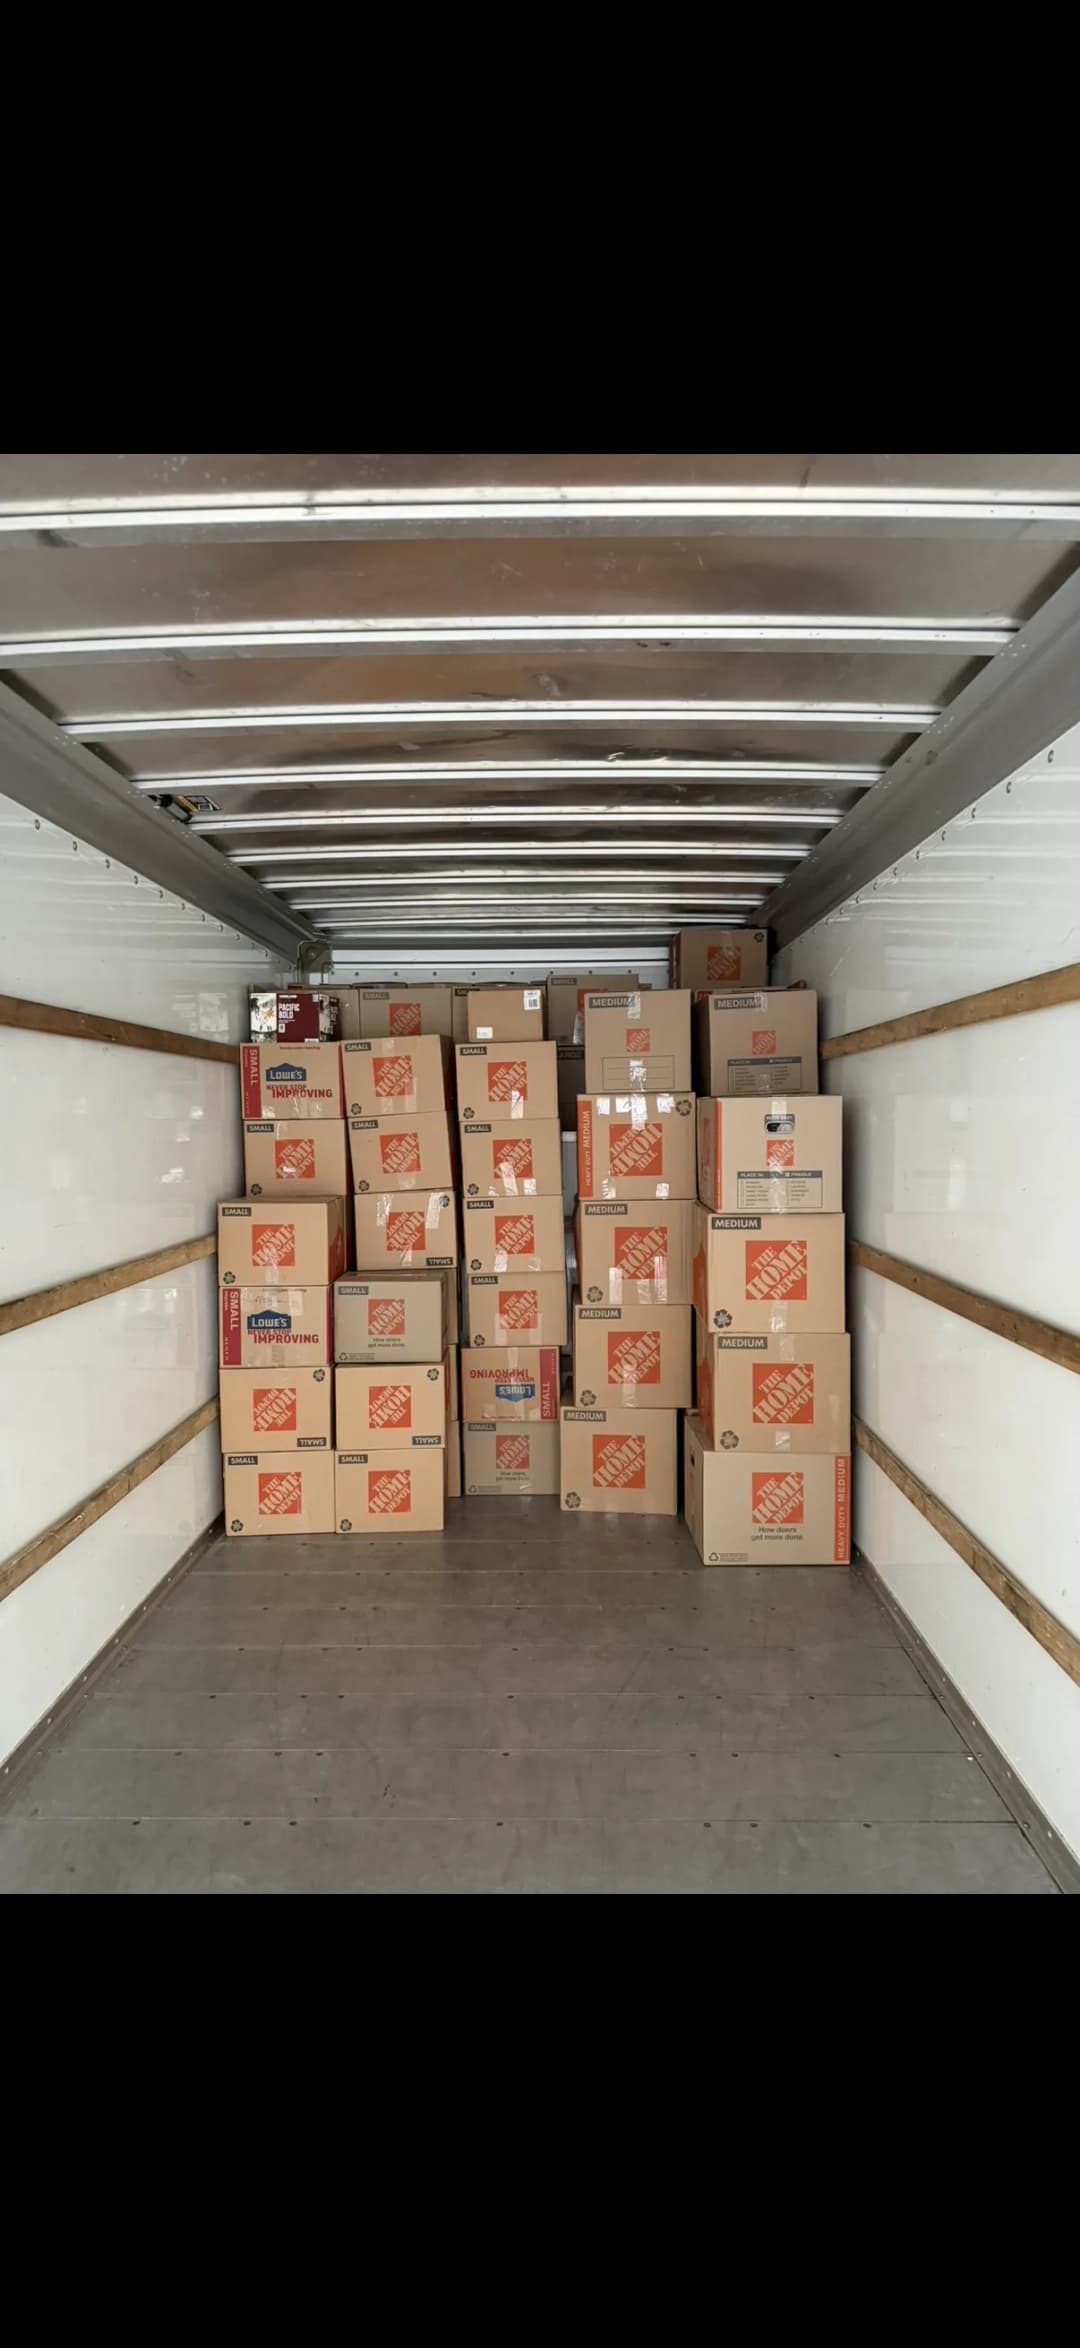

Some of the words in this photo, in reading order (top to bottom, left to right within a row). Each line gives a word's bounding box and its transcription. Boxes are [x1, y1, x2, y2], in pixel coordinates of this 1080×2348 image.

[278, 1003, 300, 1012] PACIFIC
[278, 1011, 294, 1019] BOLD
[592, 998, 632, 1007] MEDIUM
[717, 999, 759, 1008] MEDIUM
[249, 1048, 259, 1086] SMALL
[269, 1069, 303, 1080] LOWE'S
[375, 1056, 412, 1096] HOME
[489, 1061, 526, 1101] HOME
[271, 1088, 333, 1099] IMPROVING
[583, 1110, 592, 1148] MEDIUM
[276, 1139, 313, 1179] HOME
[383, 1132, 417, 1172] HOME
[610, 1124, 662, 1175] HOME
[587, 1205, 625, 1213] MEDIUM
[714, 1219, 758, 1228] MEDIUM
[252, 1224, 294, 1266] HOME
[387, 1212, 424, 1251] HOME
[496, 1215, 533, 1252] HOME
[619, 1231, 642, 1254] THE
[615, 1227, 667, 1279] HOME
[745, 1240, 807, 1300] HOME
[752, 1246, 778, 1271] THE
[769, 1262, 807, 1300] DEPOT
[230, 1291, 239, 1331] SMALL
[251, 1316, 288, 1327] LOWE'S
[369, 1299, 404, 1334] HOME
[499, 1291, 537, 1329] HOME
[582, 1309, 619, 1318] MEDIUM
[254, 1334, 319, 1344] IMPROVING
[613, 1336, 635, 1357] THE
[721, 1338, 765, 1347] MEDIUM
[470, 1368, 529, 1379] IMPROVING
[608, 1332, 660, 1383] HOME
[500, 1386, 532, 1395] LOWE'S
[753, 1363, 814, 1423] HOME
[758, 1369, 785, 1394] THE
[255, 1389, 296, 1431] HOME
[370, 1386, 410, 1427] HOME
[542, 1382, 551, 1417] SMALL
[566, 1411, 604, 1420] MEDIUM
[776, 1386, 814, 1423] DEPOT
[299, 1439, 325, 1447] SMALL
[496, 1435, 529, 1469] HOME
[598, 1440, 620, 1460] THE
[231, 1457, 256, 1465] SMALL
[593, 1434, 645, 1488] HOME
[613, 1454, 645, 1488] DEPOT
[259, 1472, 301, 1514] HOME
[368, 1471, 410, 1513] HOME
[757, 1478, 779, 1499] THE
[837, 1458, 846, 1502] MEDIUM
[752, 1472, 804, 1524] HOME
[772, 1491, 804, 1524] DEPOT
[837, 1506, 846, 1529] DUTY
[751, 1534, 763, 1542] get
[837, 1531, 846, 1558] HEAVY
